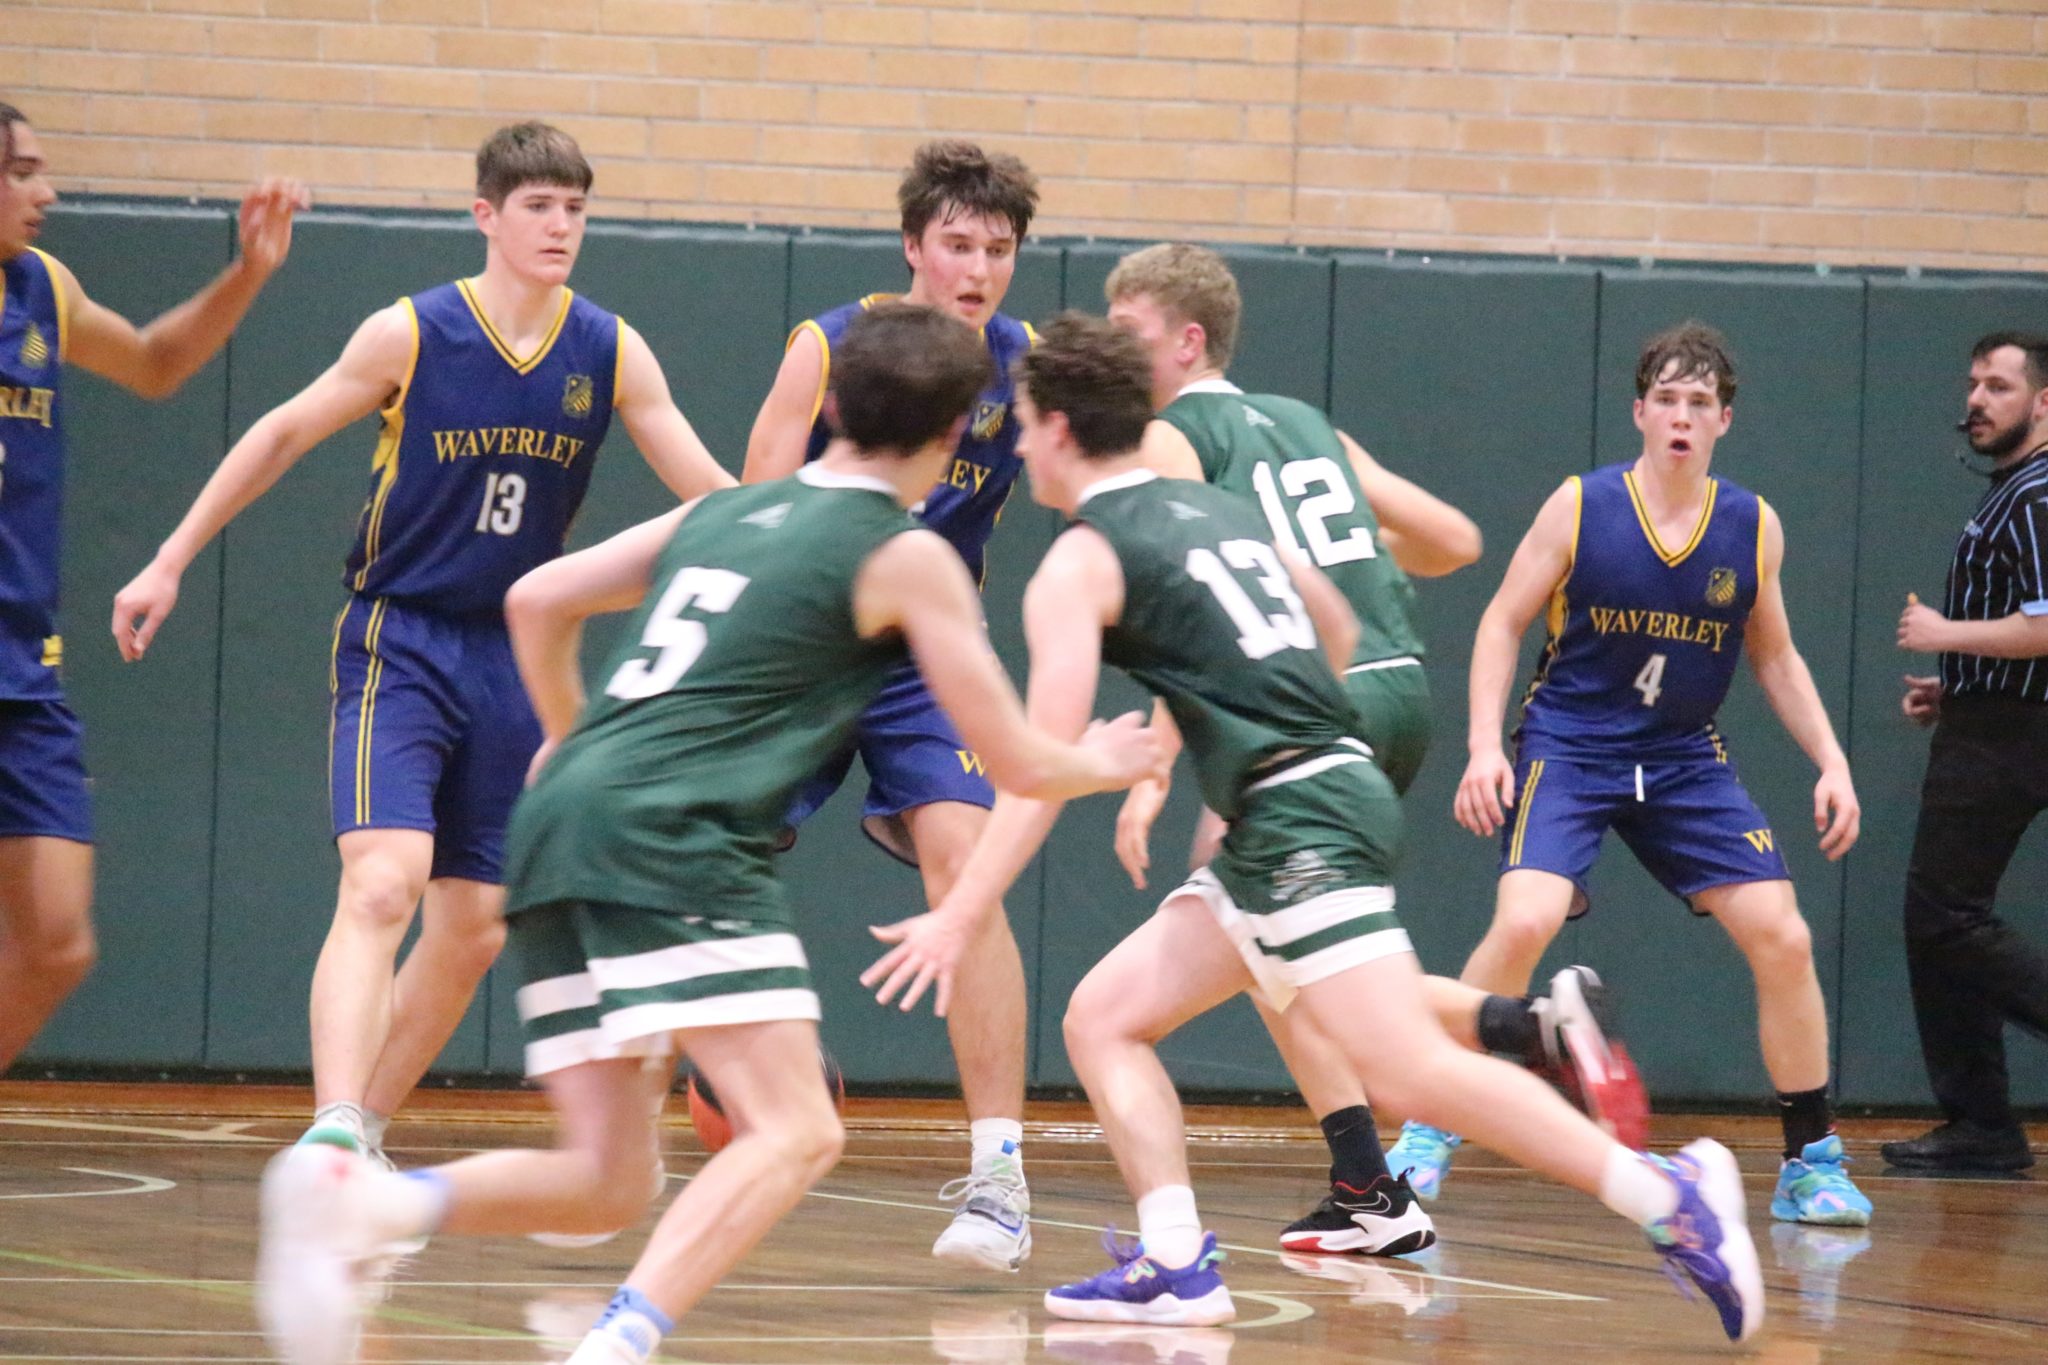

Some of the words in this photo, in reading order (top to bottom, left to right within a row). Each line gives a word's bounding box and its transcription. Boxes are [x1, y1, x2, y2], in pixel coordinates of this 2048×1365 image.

[432, 427, 584, 469] WAVERLEY
[475, 473, 527, 535] 13
[1252, 456, 1377, 567] 12
[1185, 538, 1317, 660] 13
[604, 566, 751, 700] 5
[1590, 606, 1729, 652] WAVERLEY
[1633, 654, 1667, 707] 4
[1743, 829, 1774, 854] W
